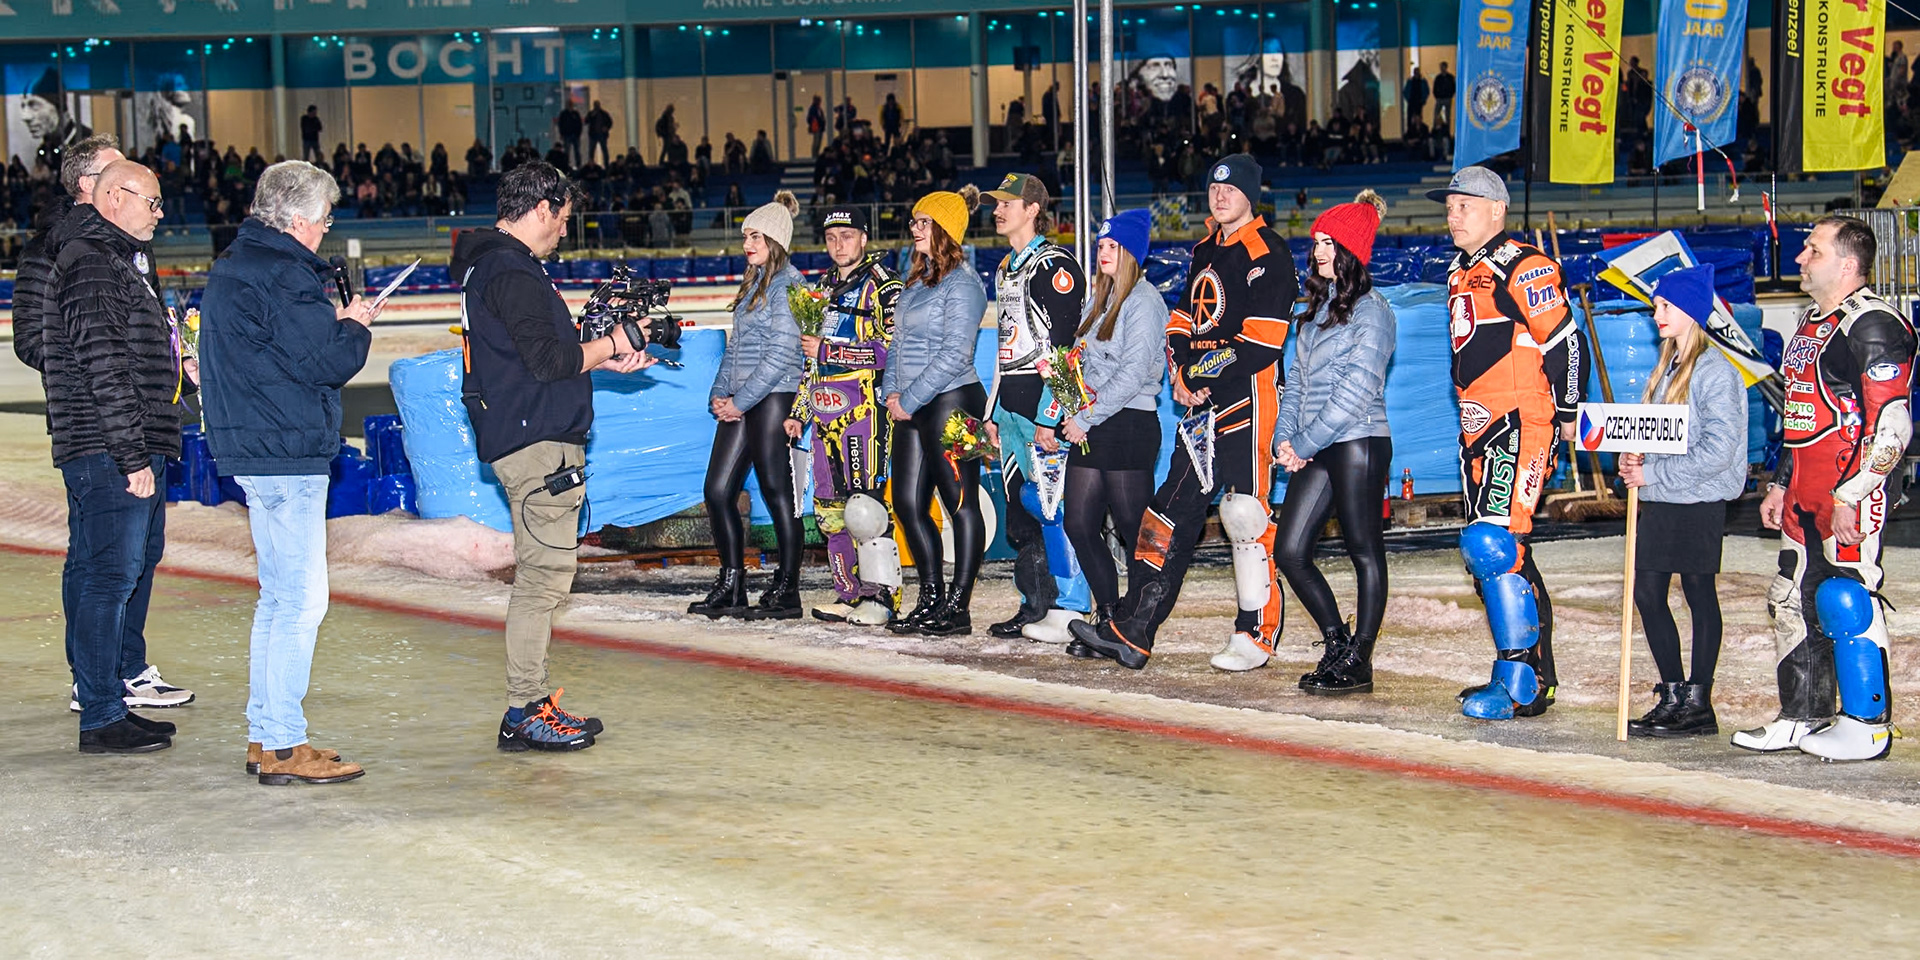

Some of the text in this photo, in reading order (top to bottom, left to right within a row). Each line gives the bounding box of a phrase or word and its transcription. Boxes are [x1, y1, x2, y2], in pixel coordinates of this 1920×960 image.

[1477, 34, 1512, 49] JAAR
[1682, 20, 1725, 38] JAAR
[343, 38, 565, 80] BOCHT
[1815, 0, 1829, 118] KONSTRUKTIE
[1831, 26, 1875, 119] Vegt
[1559, 23, 1575, 133] KONSTRUKTIE
[1573, 51, 1614, 136] Vegt
[1467, 248, 1488, 267] WACO
[1515, 265, 1555, 287] Mitas
[1526, 284, 1557, 309] bm
[1189, 349, 1234, 378] Putoline
[814, 392, 843, 407] PBR
[1605, 415, 1684, 442] CZECH REPUBLIC
[1868, 484, 1884, 536] WAC
